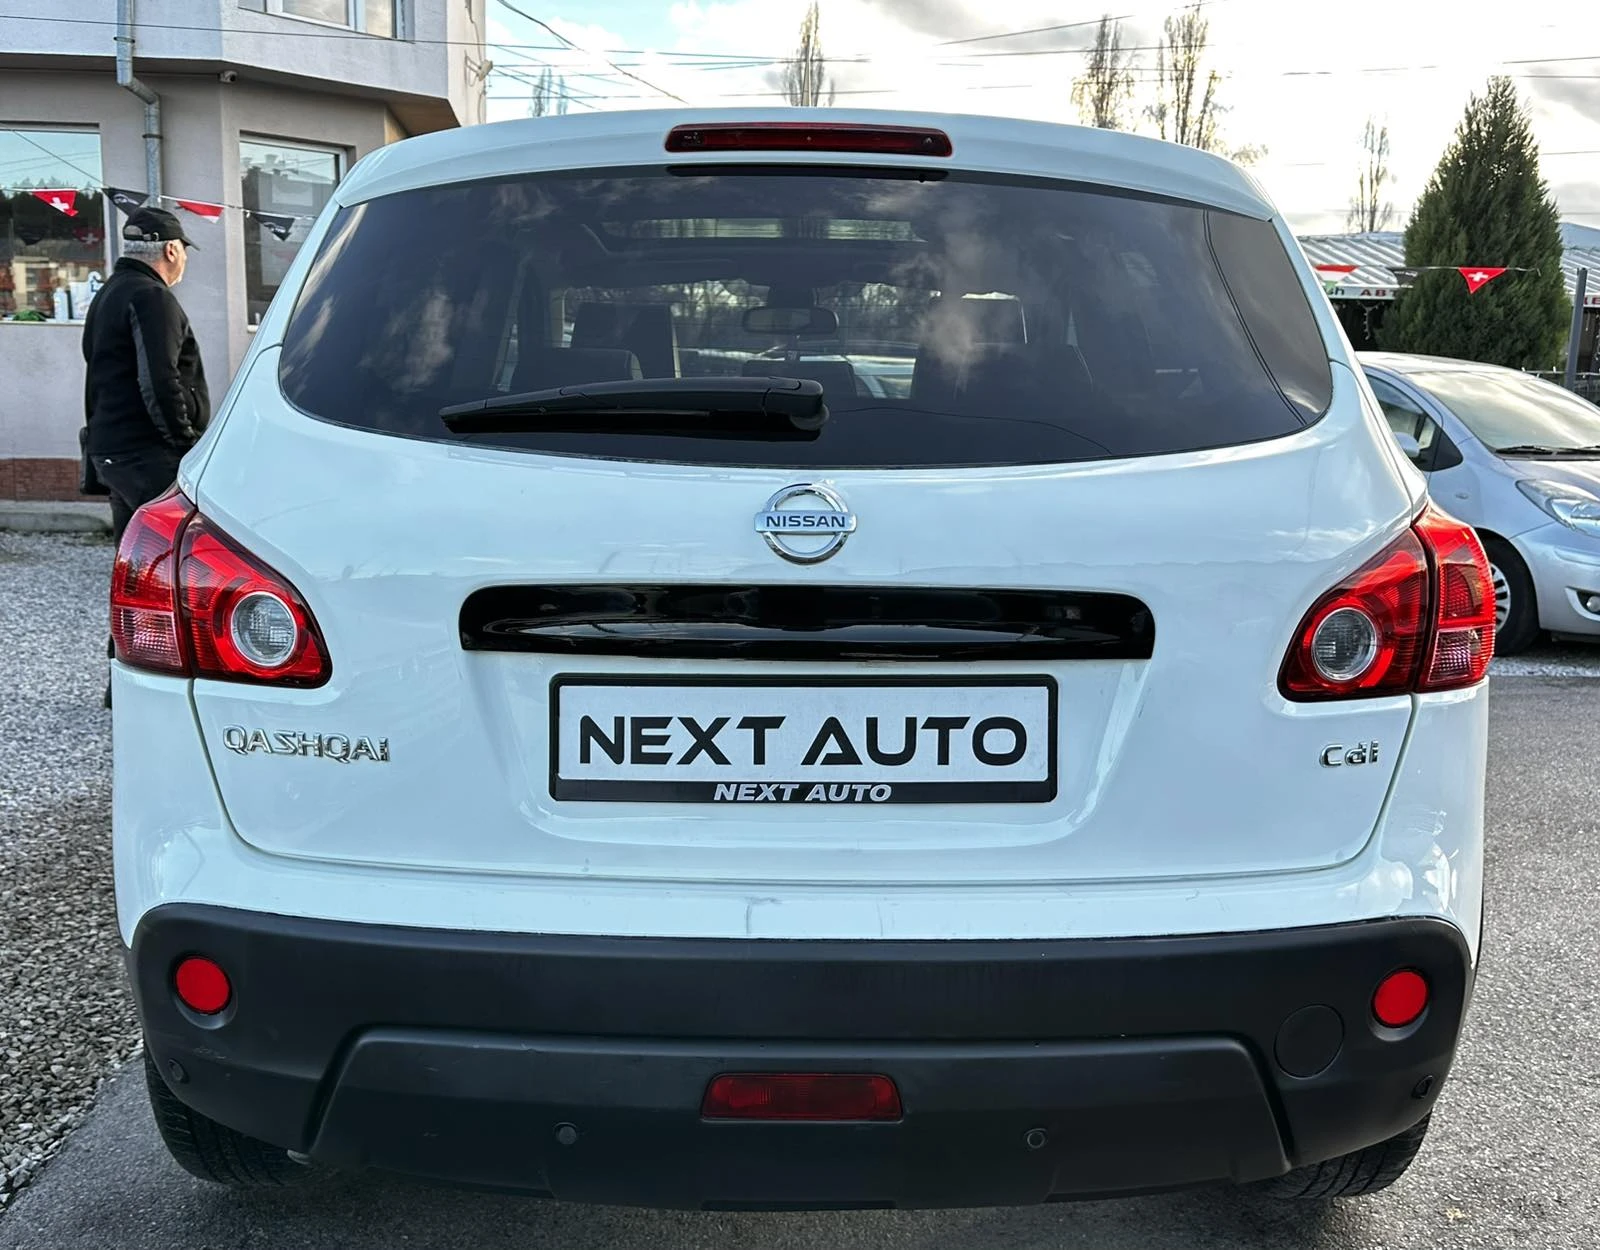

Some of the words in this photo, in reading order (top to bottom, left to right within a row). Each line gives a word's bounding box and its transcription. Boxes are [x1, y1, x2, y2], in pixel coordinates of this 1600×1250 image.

[766, 515, 845, 528] NISSAN
[579, 714, 787, 766] NEXT
[800, 715, 1028, 767] AUTO
[713, 783, 800, 802] NEXT
[804, 784, 893, 803] AUTO
